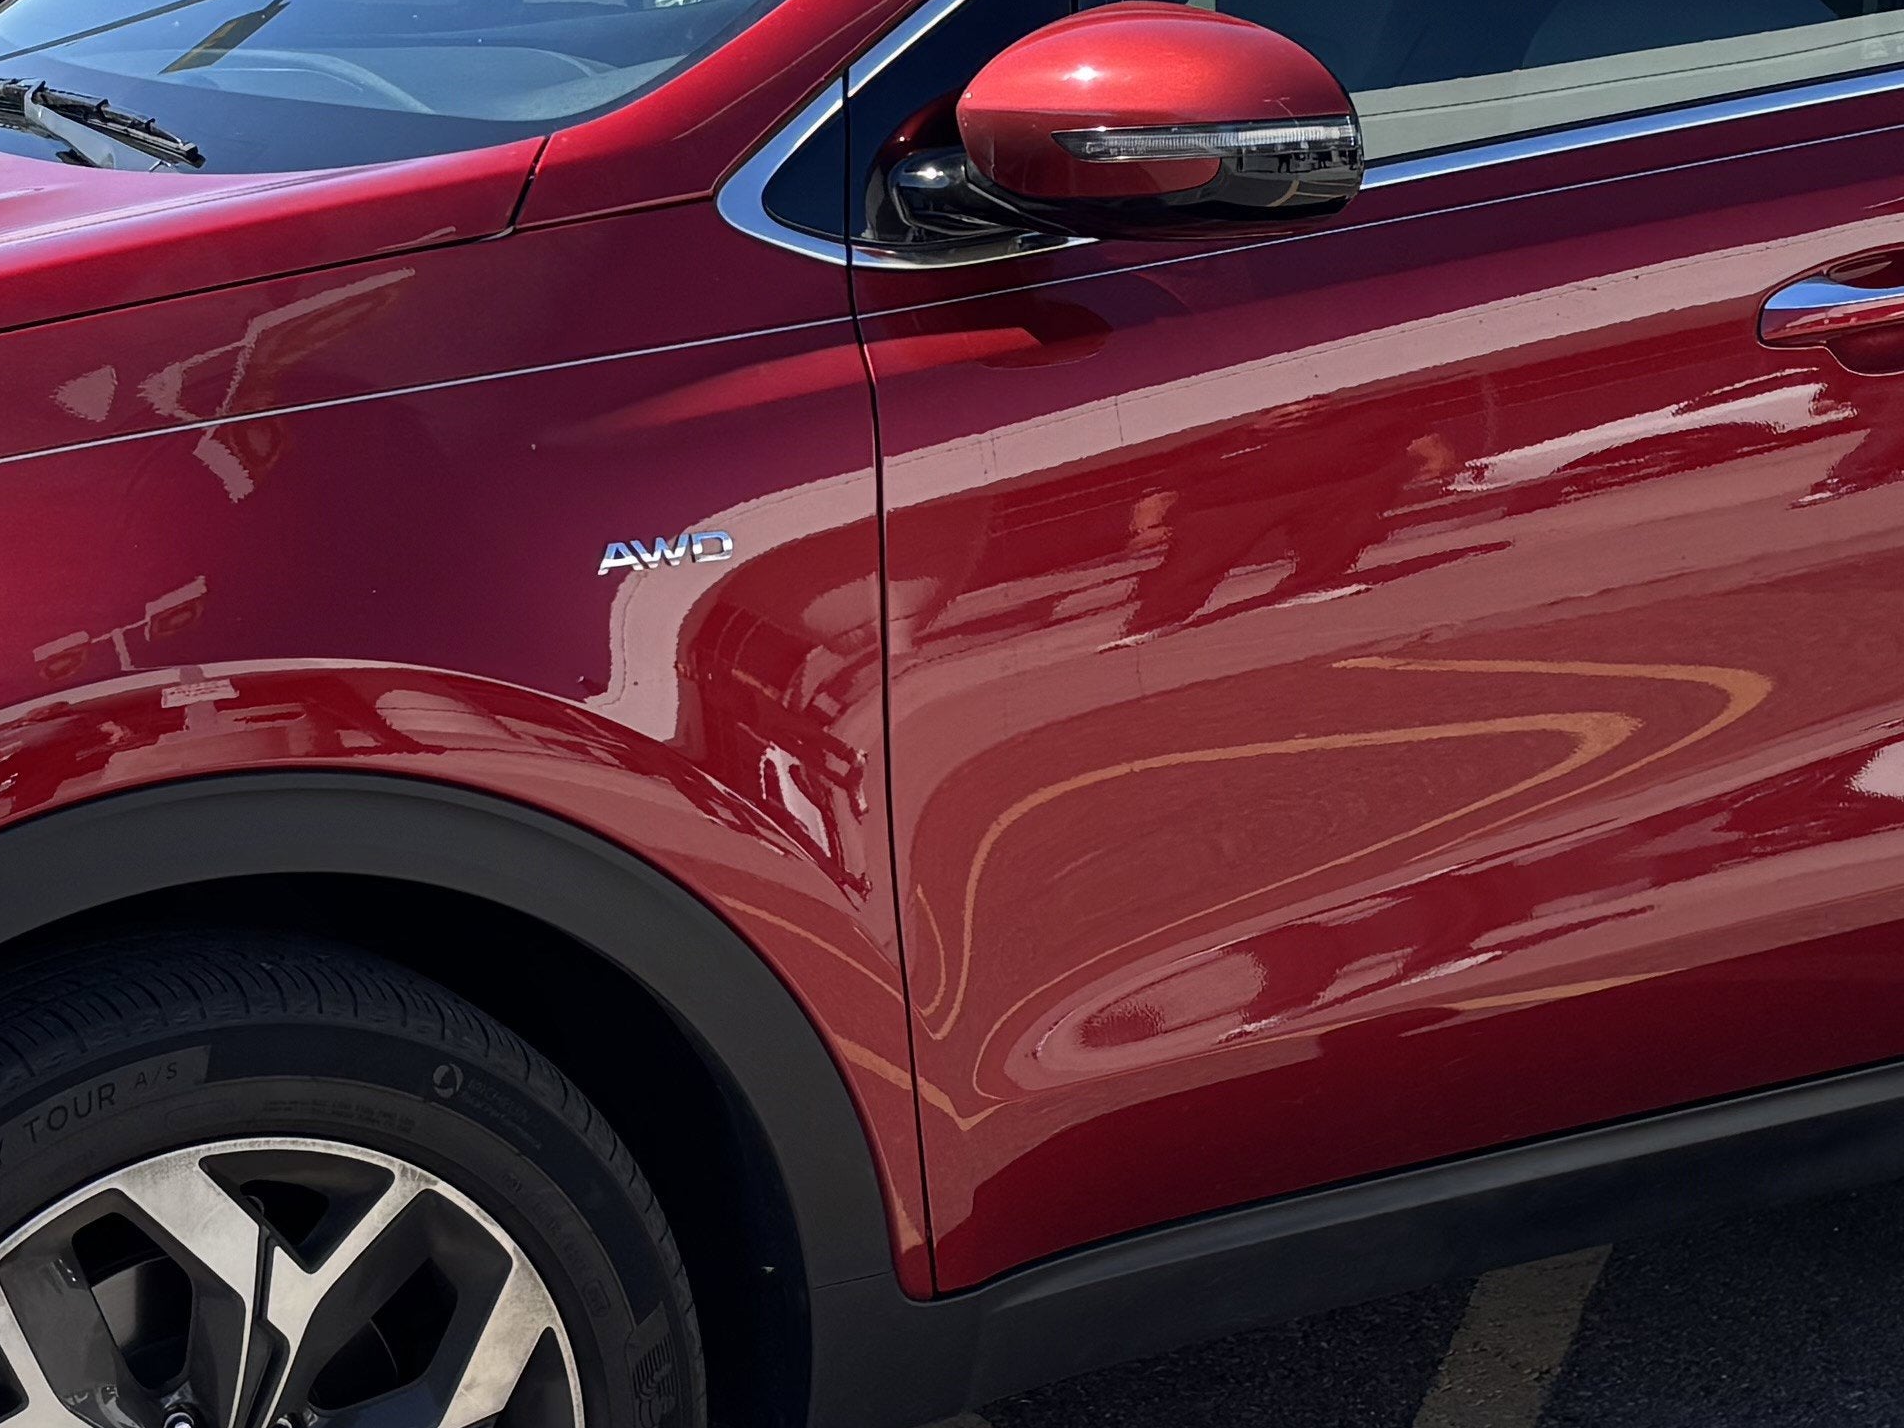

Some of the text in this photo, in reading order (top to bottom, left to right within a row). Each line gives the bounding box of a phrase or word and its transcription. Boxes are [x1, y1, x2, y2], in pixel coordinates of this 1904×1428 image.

[597, 530, 733, 576] AWD
[23, 1082, 119, 1149] TOUR
[133, 1060, 180, 1092] A/S
